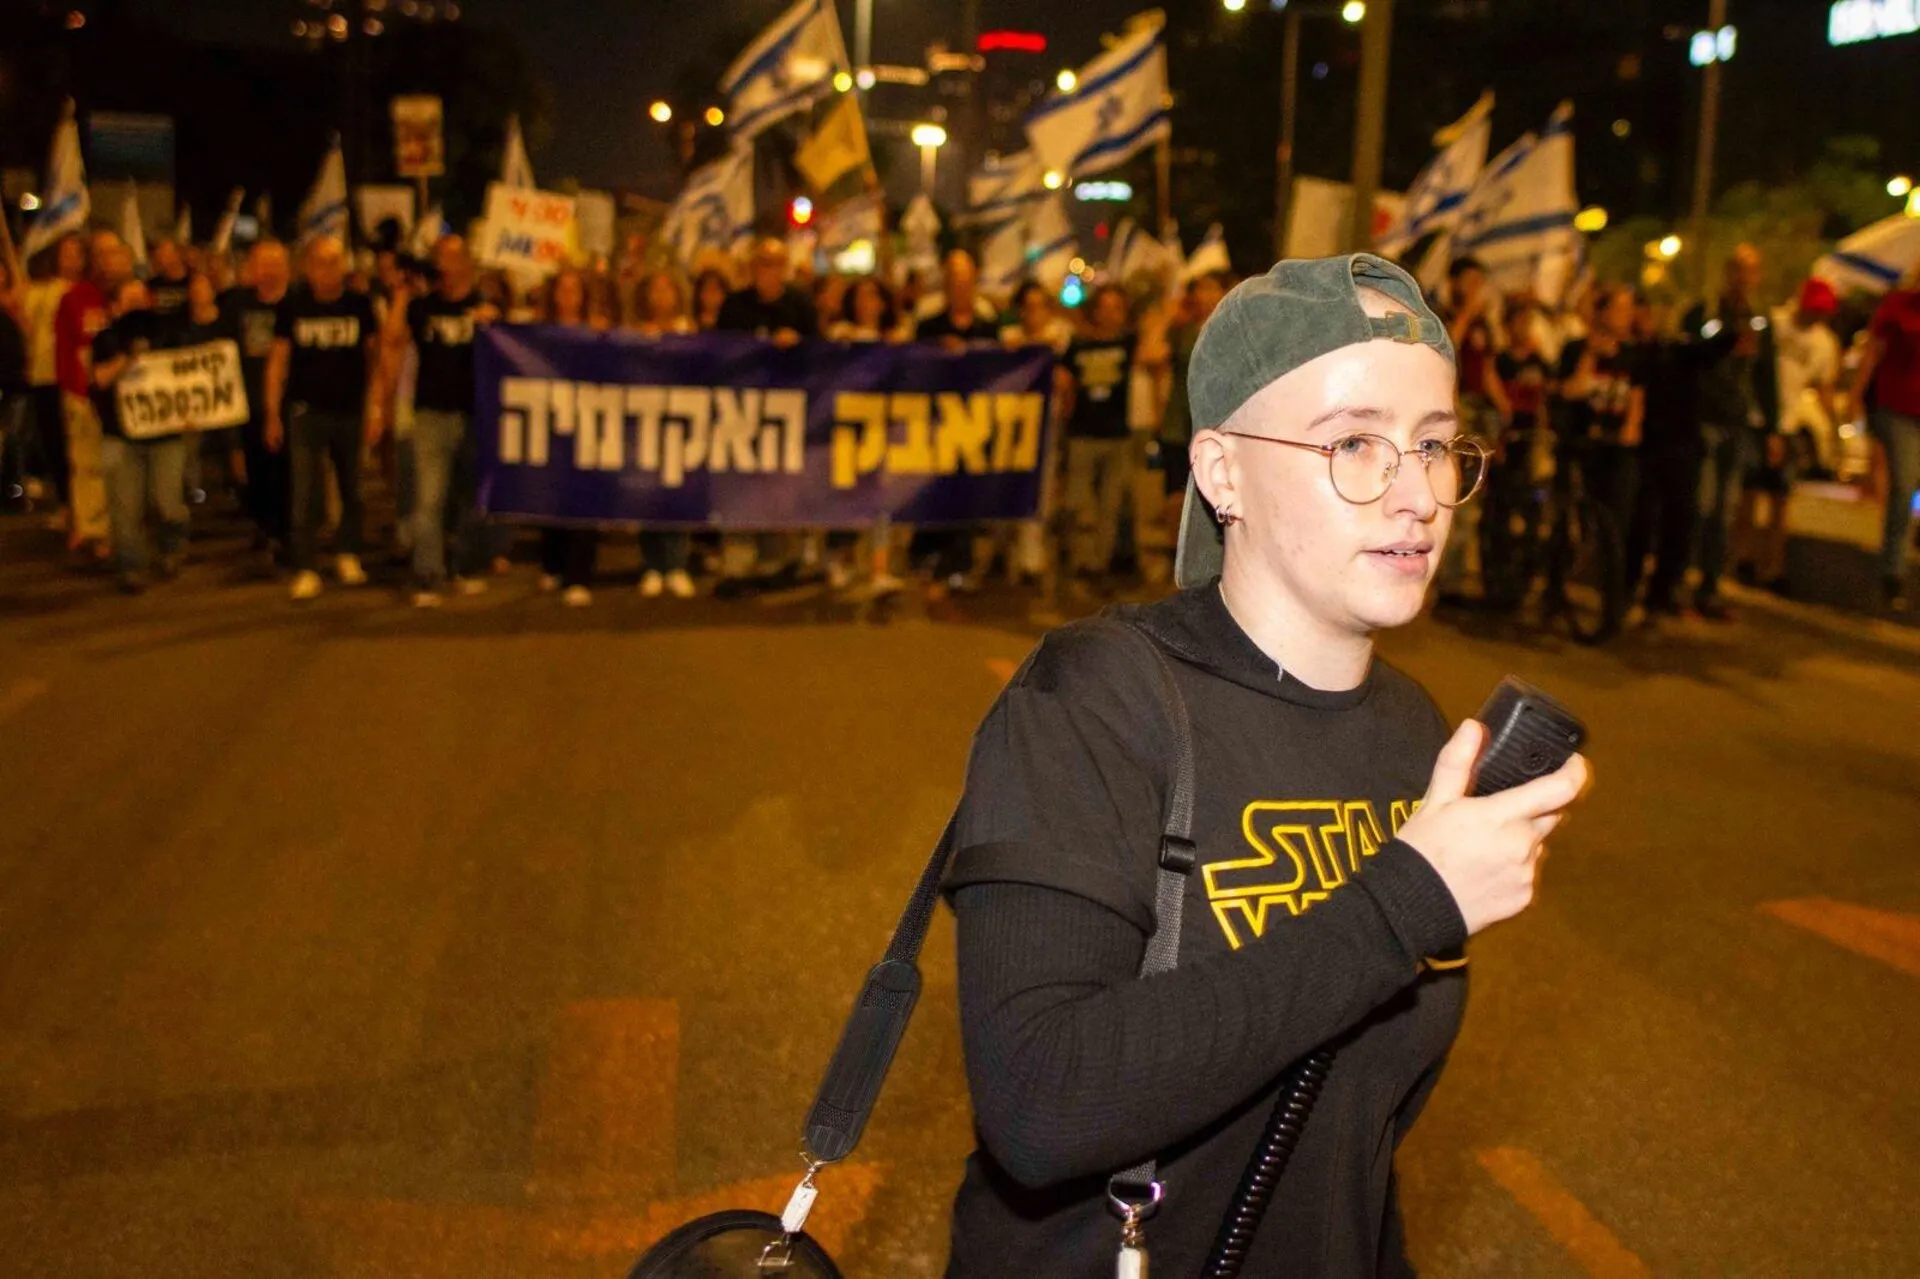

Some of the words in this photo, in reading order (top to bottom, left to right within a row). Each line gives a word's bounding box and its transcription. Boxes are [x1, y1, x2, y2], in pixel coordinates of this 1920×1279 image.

[501, 377, 806, 487] האקדמיה
[831, 392, 1043, 489] מאבק
[1201, 799, 1423, 899] STA
